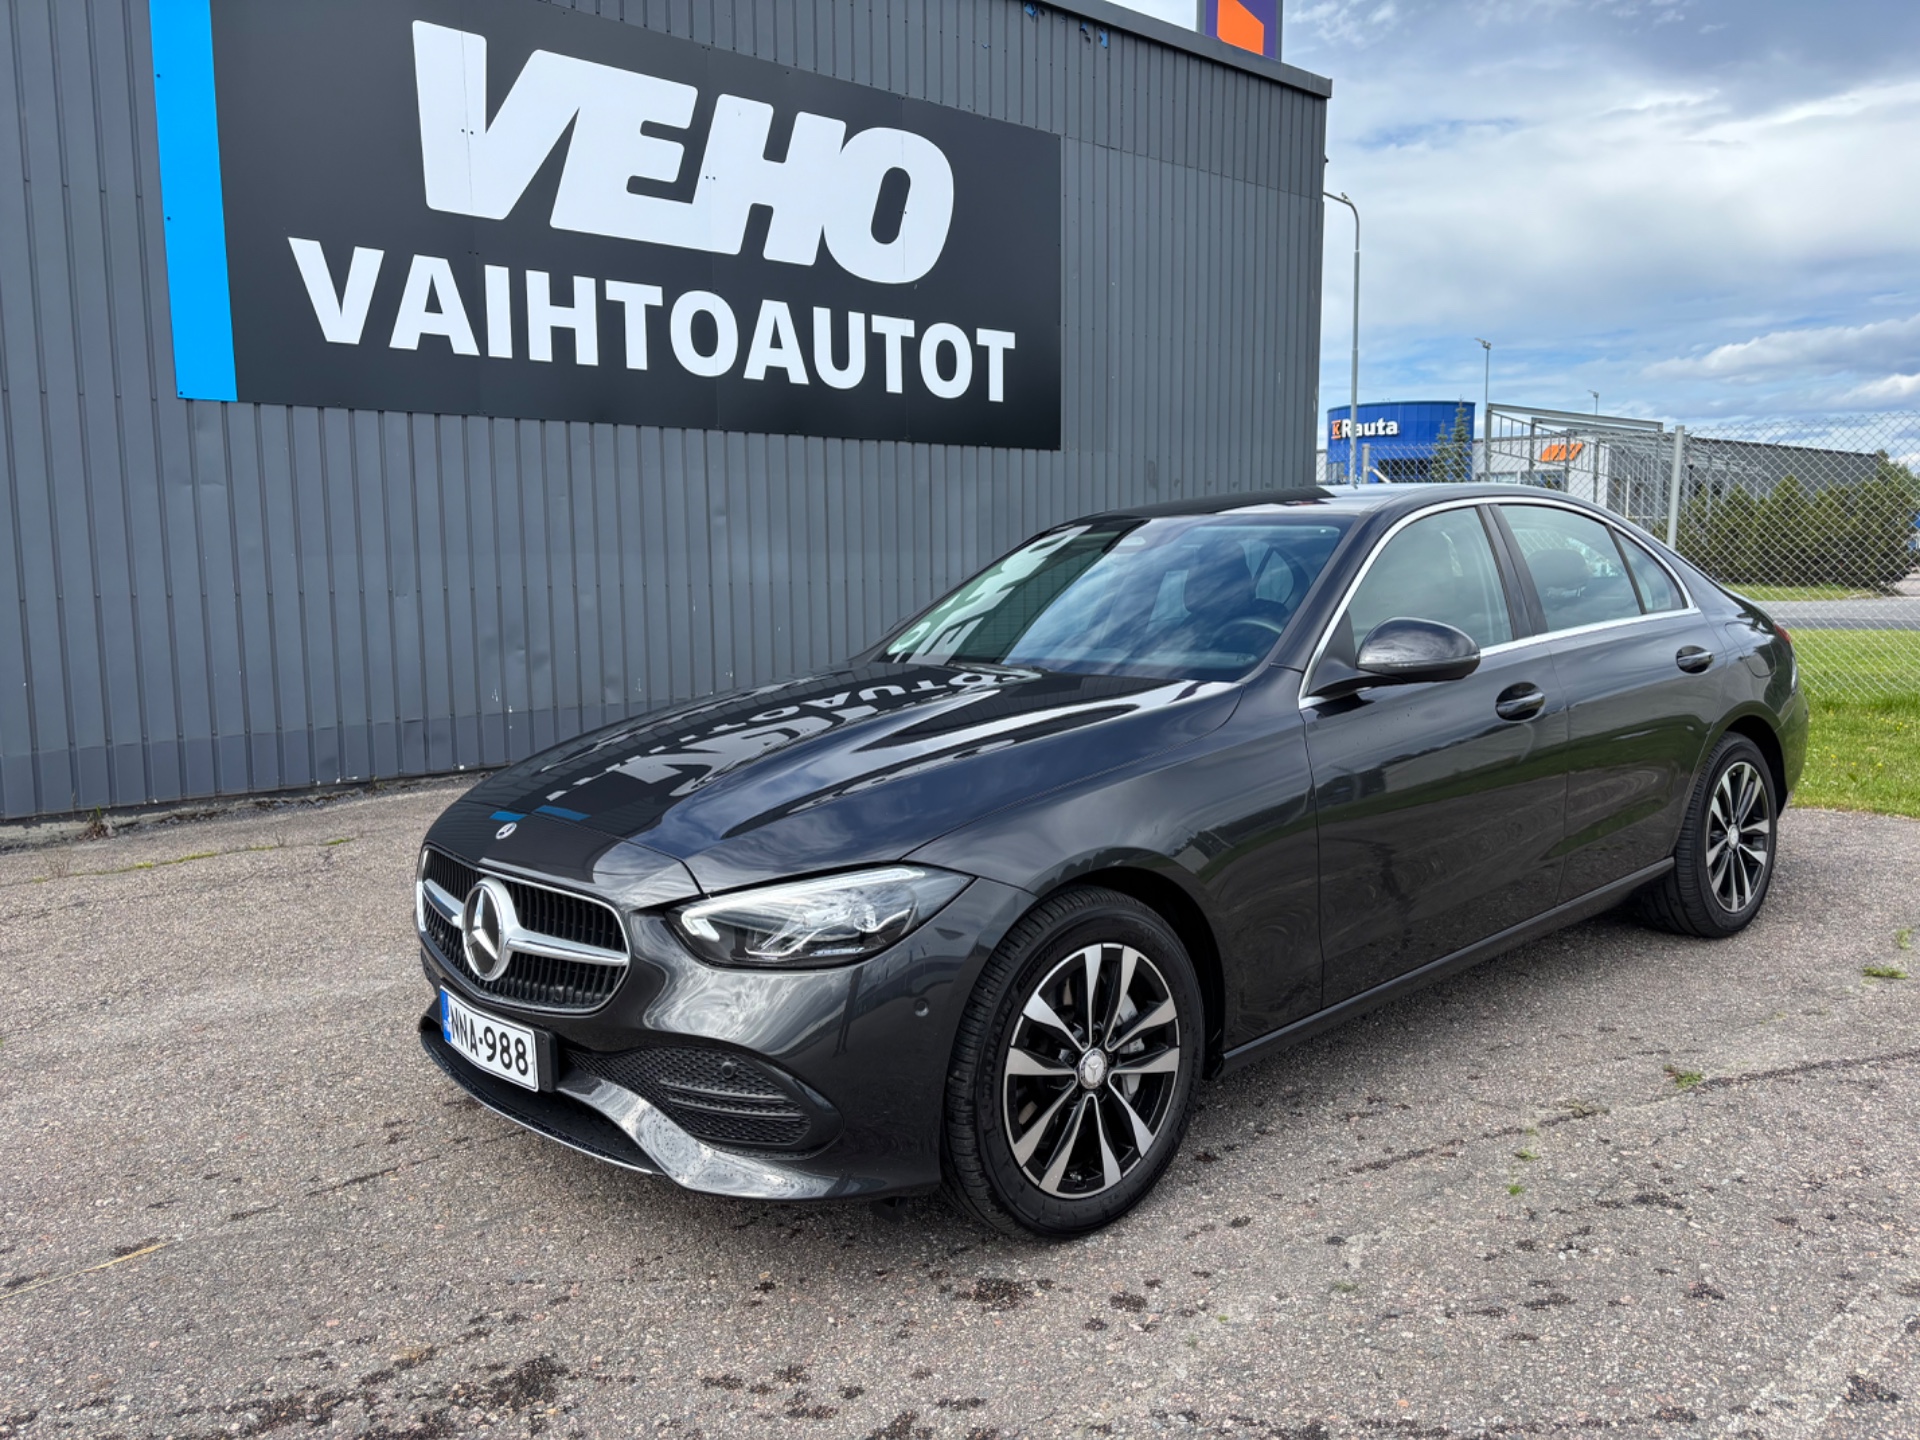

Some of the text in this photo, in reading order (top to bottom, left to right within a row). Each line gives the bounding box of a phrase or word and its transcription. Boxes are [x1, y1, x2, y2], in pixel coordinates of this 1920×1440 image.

[412, 20, 953, 284] VEHO
[288, 237, 1015, 402] VAIHTOAUTOT
[450, 1004, 528, 1076] NNA-988
